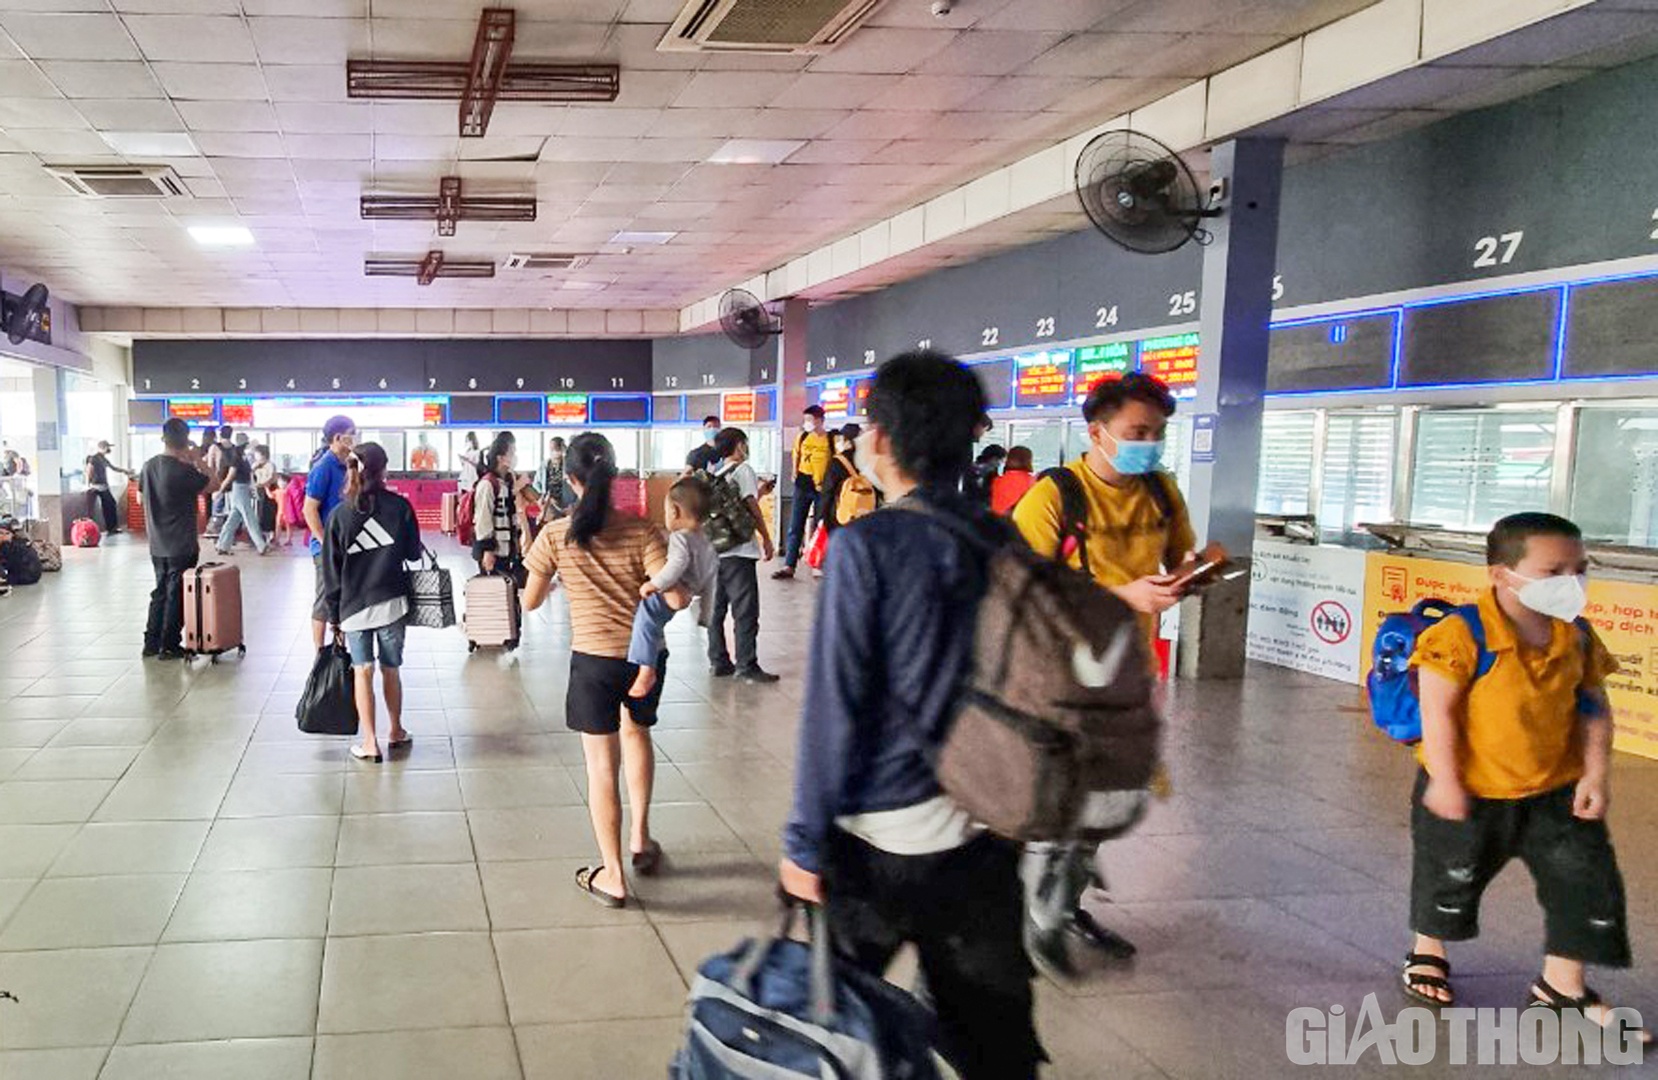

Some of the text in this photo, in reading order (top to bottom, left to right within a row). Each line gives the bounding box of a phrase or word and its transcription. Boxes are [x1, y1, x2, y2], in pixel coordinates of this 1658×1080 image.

[1473, 230, 1525, 268] 27
[1168, 290, 1197, 317] 25
[1095, 305, 1119, 329] 24
[1035, 316, 1056, 338] 23
[981, 326, 999, 347] 22
[144, 378, 151, 390] 1
[191, 378, 200, 390] 2
[239, 378, 247, 390] 3
[286, 378, 296, 390] 4
[332, 378, 341, 389] 5
[378, 378, 387, 389] 6
[428, 378, 436, 389] 7
[468, 378, 477, 389] 8
[516, 378, 524, 389] 9
[560, 378, 574, 389] 10
[611, 378, 624, 389] 11
